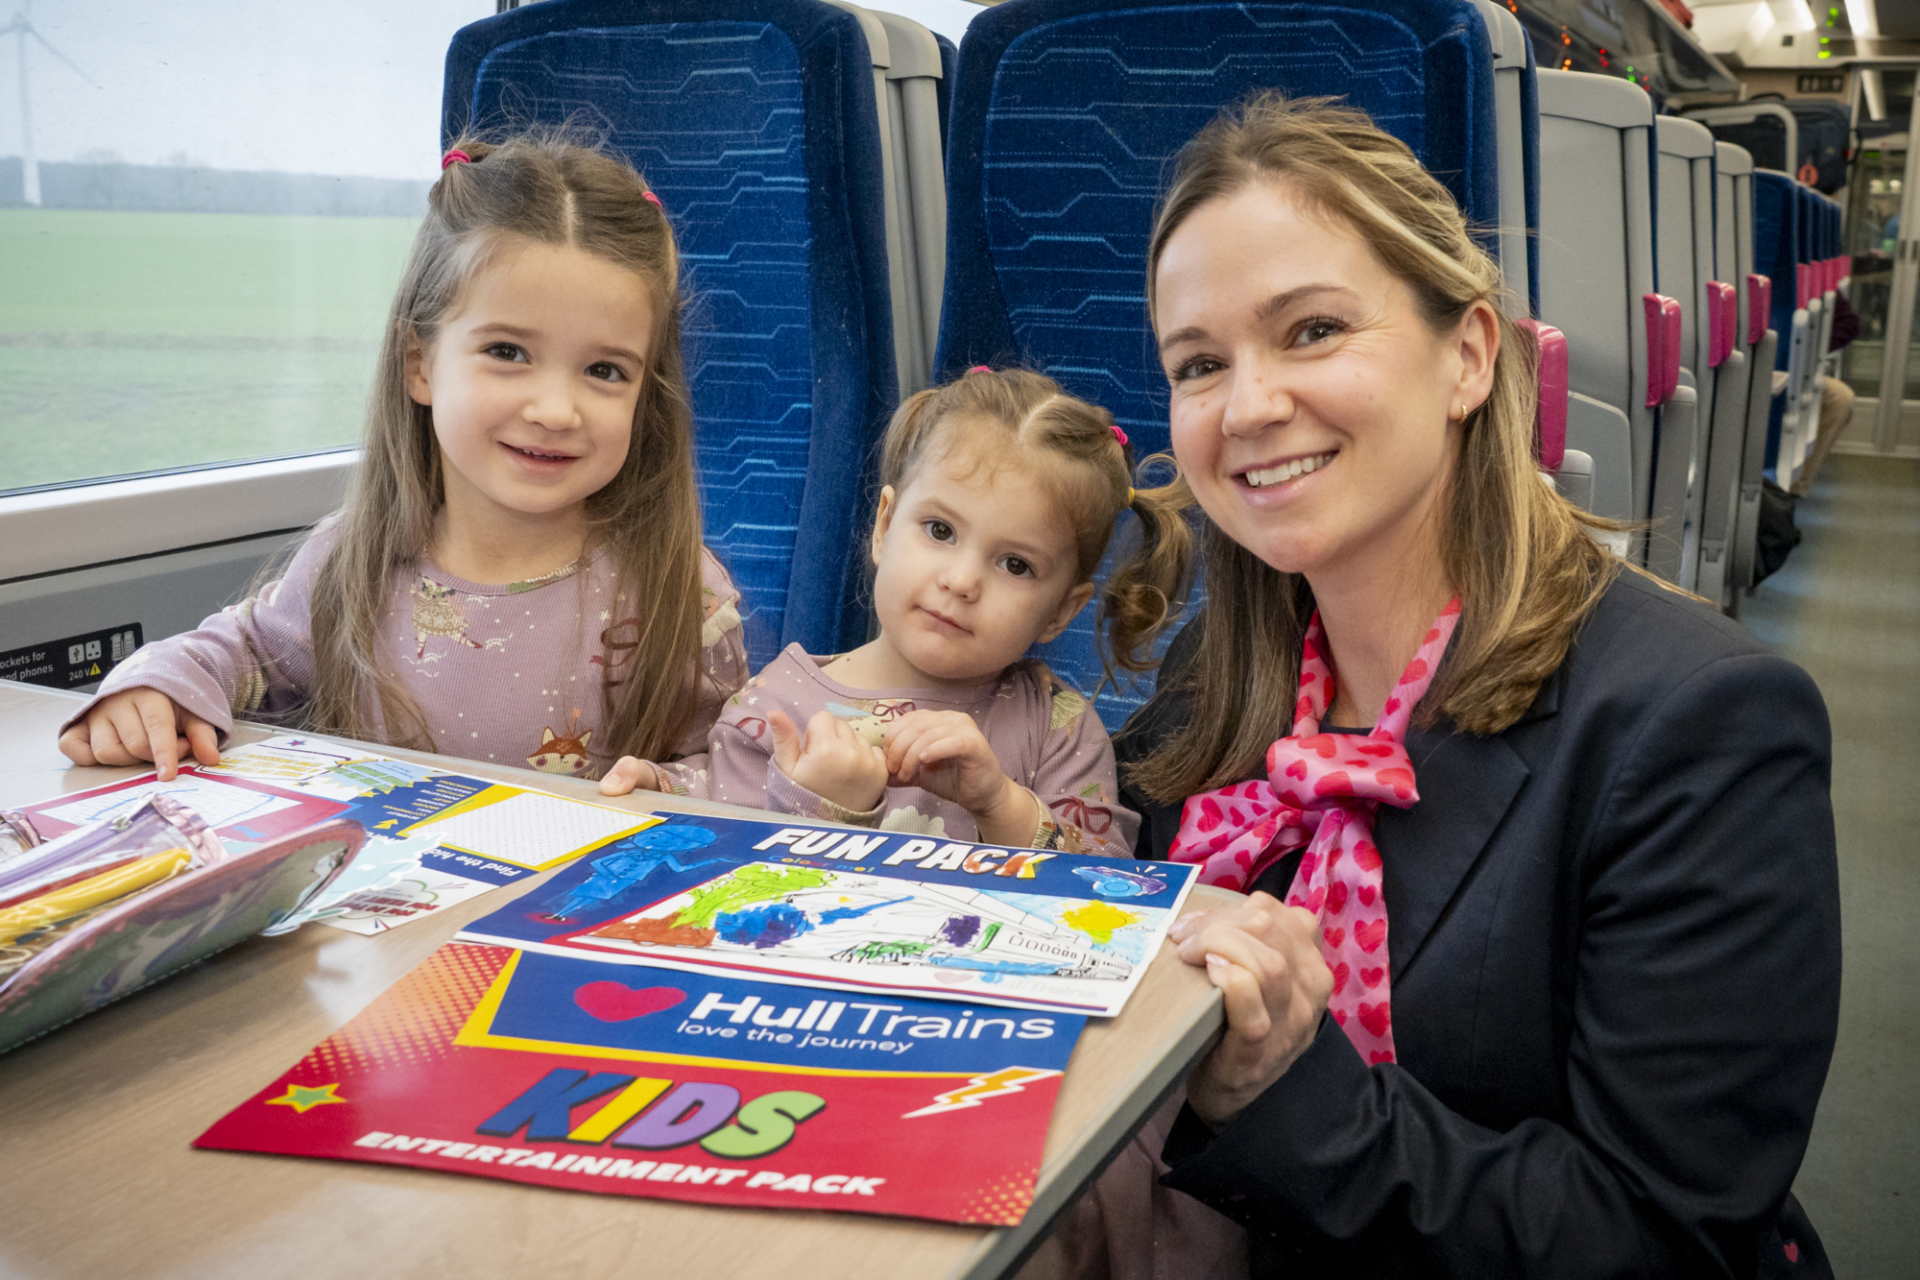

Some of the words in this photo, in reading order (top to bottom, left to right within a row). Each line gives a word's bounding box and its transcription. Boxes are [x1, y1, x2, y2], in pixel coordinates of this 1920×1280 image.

[32, 651, 46, 662] for
[19, 664, 54, 681] phones
[69, 671, 84, 681] 240
[455, 854, 482, 869] the
[751, 828, 890, 862] FUN
[882, 839, 1060, 880] PACK
[478, 861, 522, 877] Find
[676, 1019, 739, 1039] love
[746, 1026, 794, 1044] the
[796, 1032, 915, 1055] journey
[475, 1066, 828, 1161] KIDS
[353, 1130, 749, 1187] ENTERTAINMENT
[744, 1168, 888, 1196] PACK
